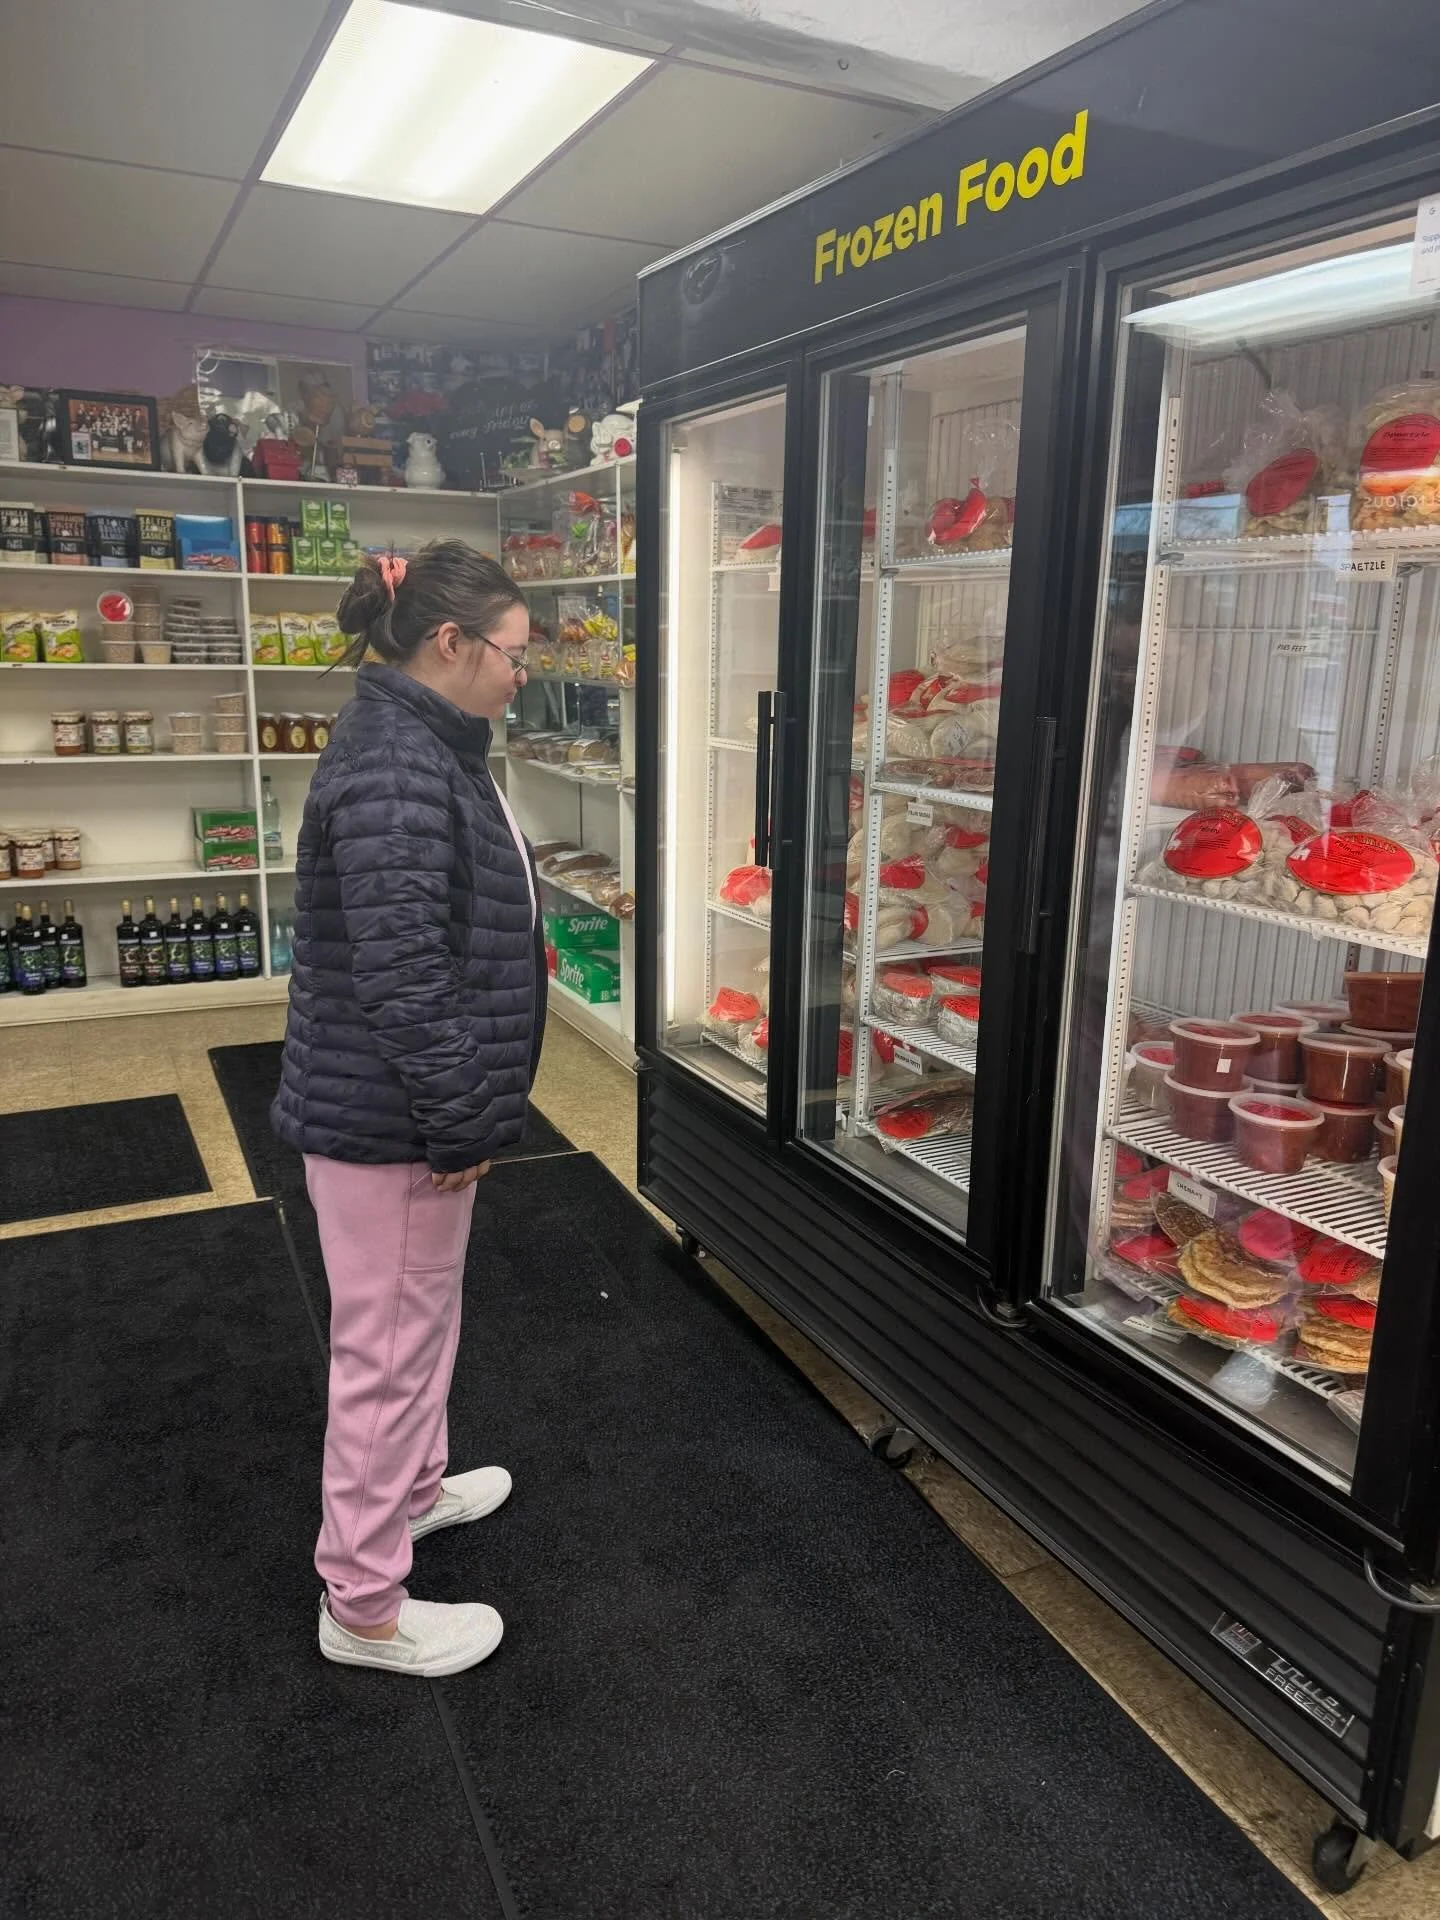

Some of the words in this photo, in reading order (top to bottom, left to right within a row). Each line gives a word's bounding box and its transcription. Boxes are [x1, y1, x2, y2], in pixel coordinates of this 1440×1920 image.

[814, 190, 944, 285] Frozen
[955, 108, 1089, 227] Food
[1339, 560, 1386, 572] SPAETZLE
[567, 917, 608, 935] Sprite
[560, 957, 584, 988] Sprite
[1265, 1667, 1337, 1727] FREEZER
